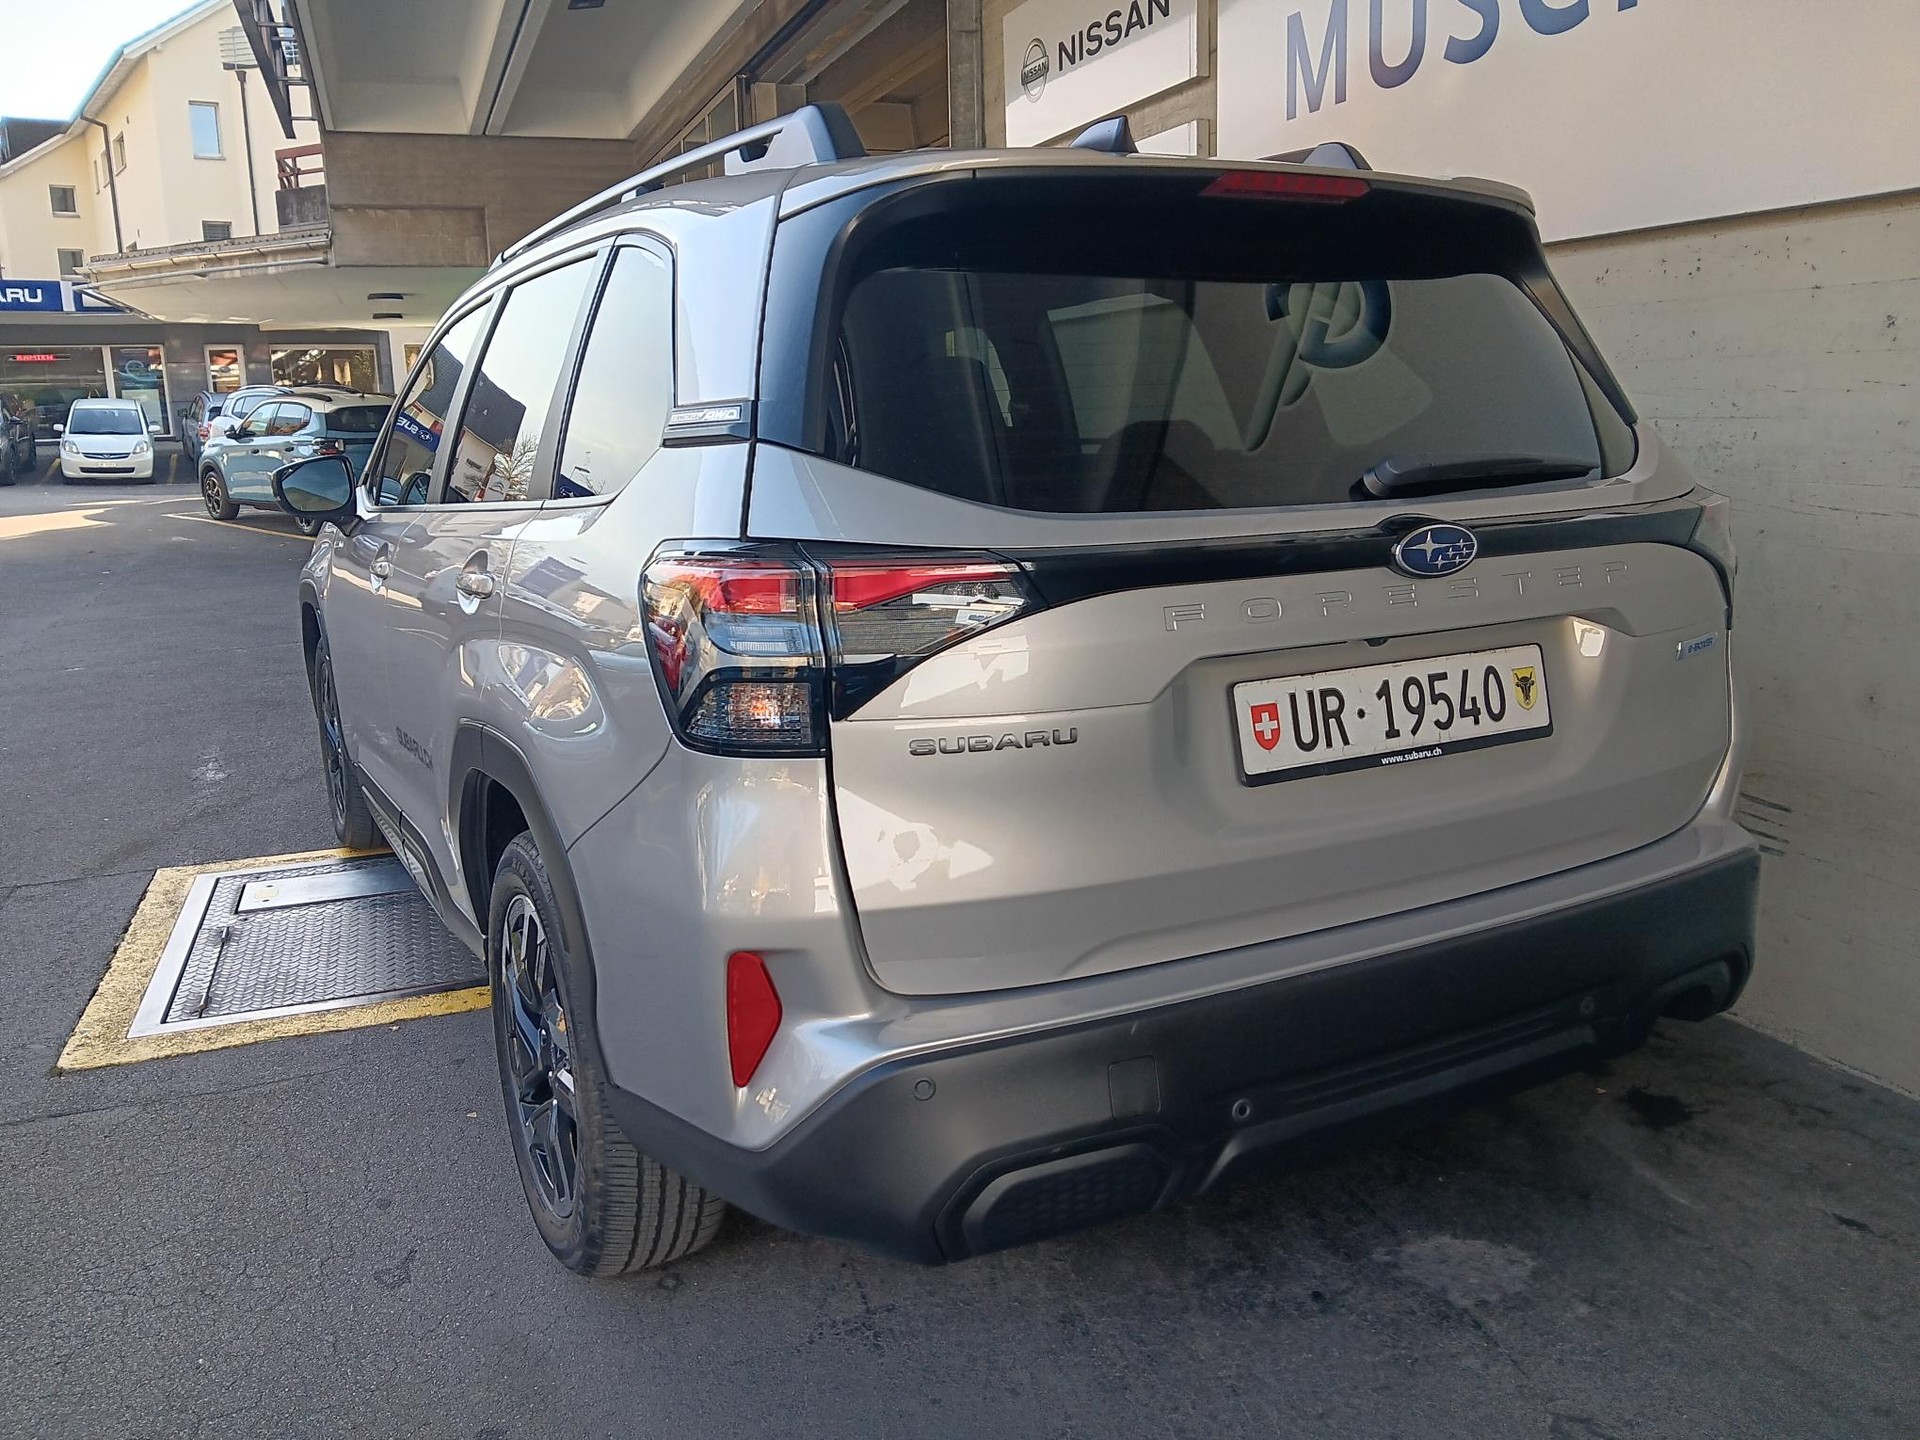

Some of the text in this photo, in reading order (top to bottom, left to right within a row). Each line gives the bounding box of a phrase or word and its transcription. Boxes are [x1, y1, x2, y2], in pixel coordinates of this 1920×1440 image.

[1058, 0, 1170, 71] NISSAN
[1023, 60, 1047, 80] NISSAN
[1286, 0, 1638, 120] MUS
[0, 288, 42, 302] RU
[1164, 560, 1627, 632] FORESTER
[909, 727, 1078, 756] SUBARU
[1381, 747, 1442, 765] www.subaru.ch
